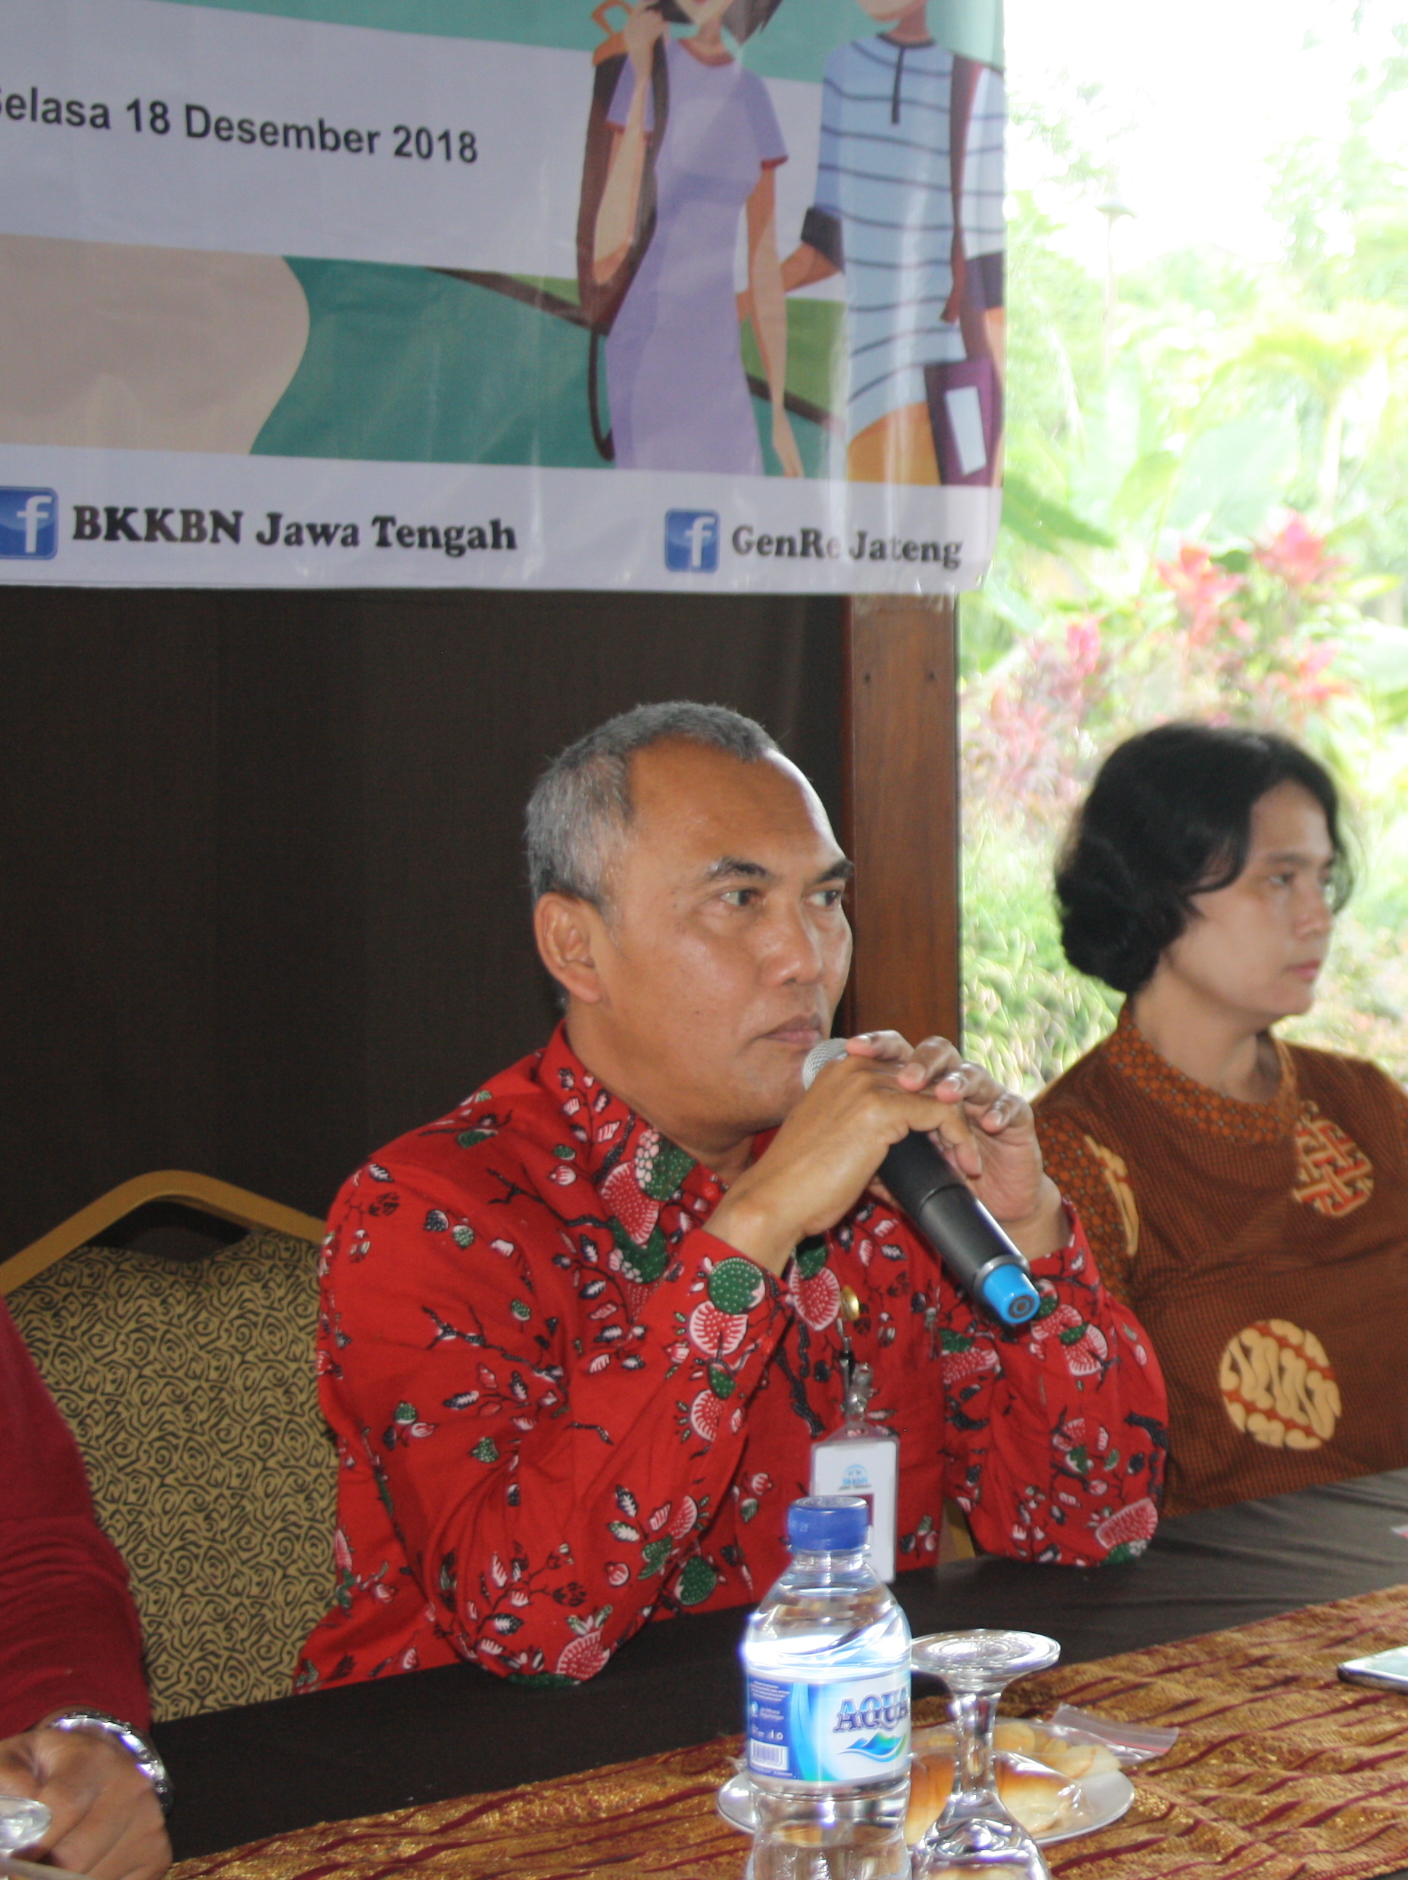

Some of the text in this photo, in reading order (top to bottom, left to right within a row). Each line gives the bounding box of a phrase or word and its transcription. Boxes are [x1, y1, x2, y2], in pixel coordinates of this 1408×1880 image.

[0, 86, 479, 164] elasa 18 Desember 2018
[72, 504, 244, 544] BKKBN
[255, 512, 360, 548] Jawa
[371, 514, 518, 558] Tengah
[731, 524, 841, 561] GenRe
[847, 530, 964, 570] Jateng
[833, 1684, 909, 1733] AQUA
